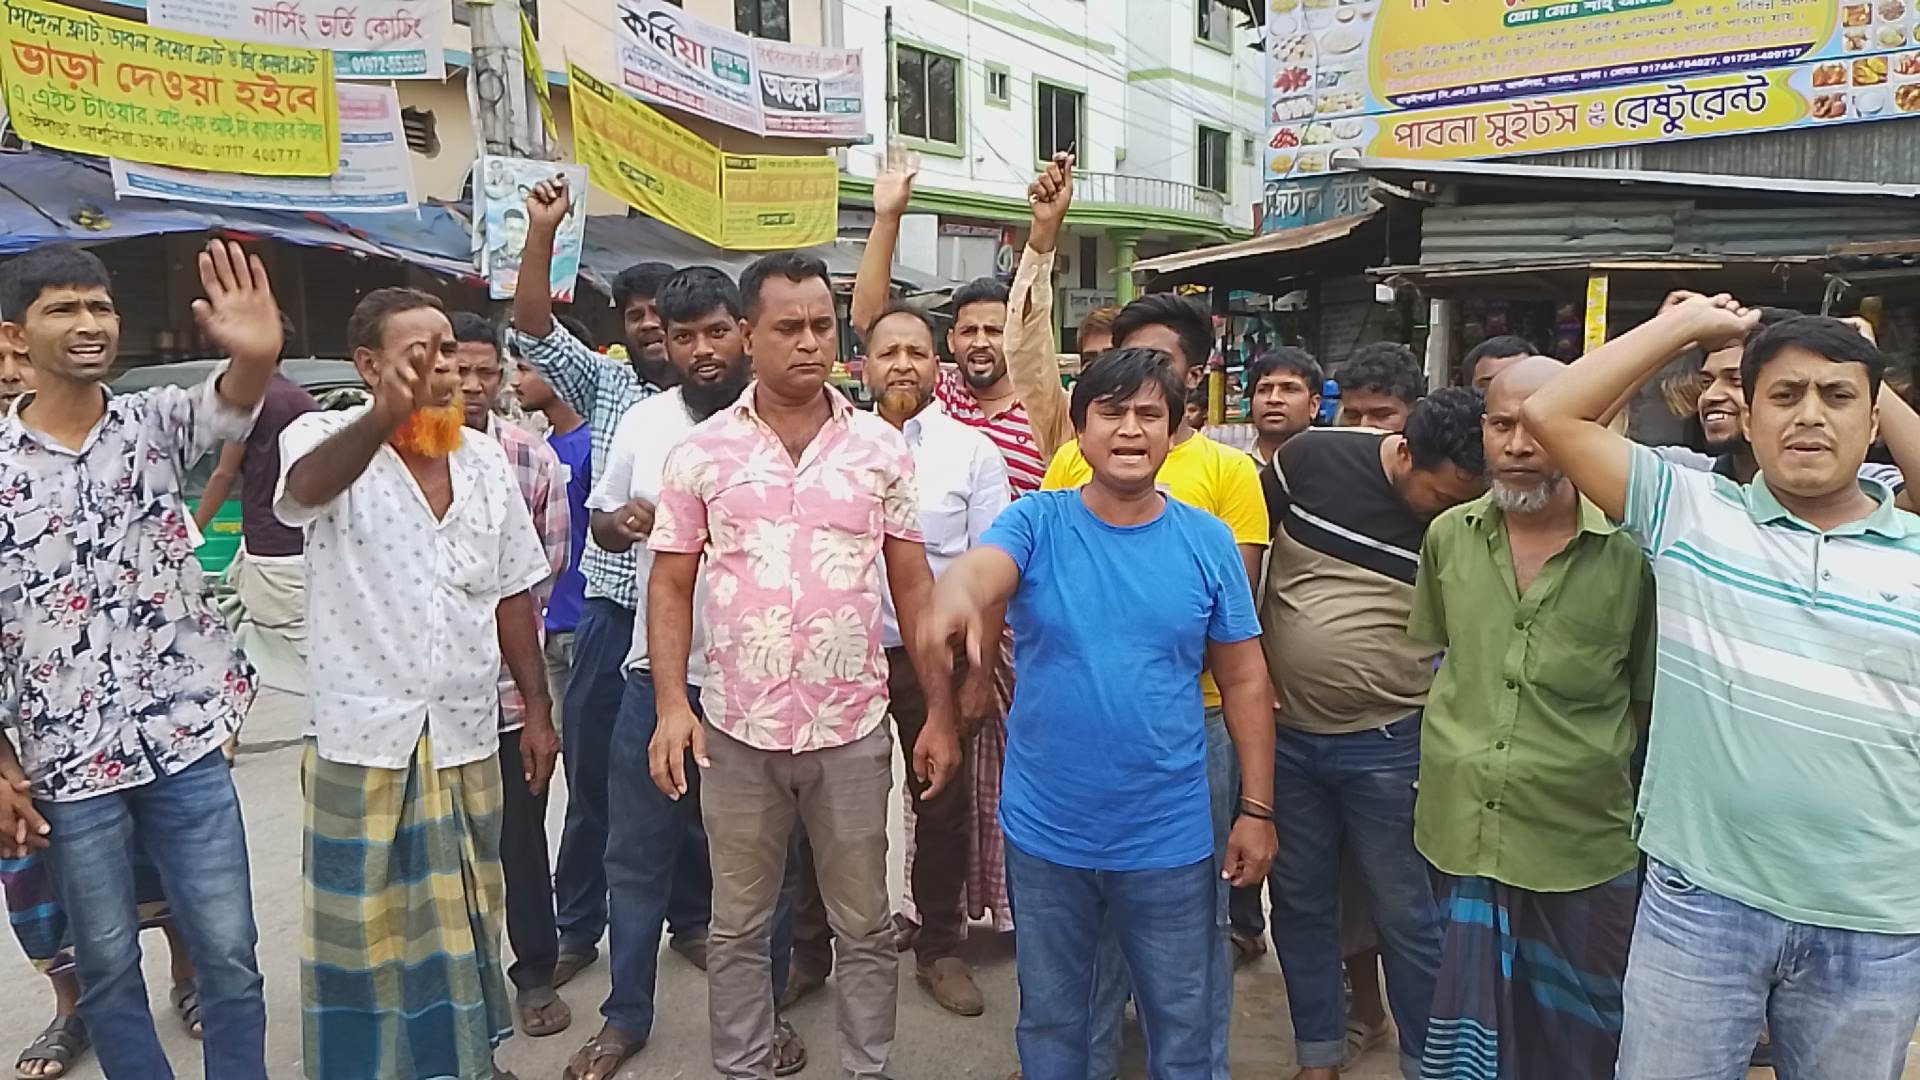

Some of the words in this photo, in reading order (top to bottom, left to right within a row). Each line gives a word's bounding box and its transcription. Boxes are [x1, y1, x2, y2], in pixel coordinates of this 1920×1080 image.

[252, 1, 308, 41] নার্সিং
[315, 6, 358, 37] ভর্তি
[364, 8, 425, 42] কোচিং
[617, 4, 706, 69] কর্নিয়া
[10, 39, 105, 90] ভাড়া
[117, 63, 223, 107] দেওয়া
[234, 72, 317, 116] হইবে
[1394, 116, 1478, 149] পাবনা
[1485, 101, 1578, 147] সুইটস
[1614, 75, 1769, 135] রেষ্টুরেন্ট
